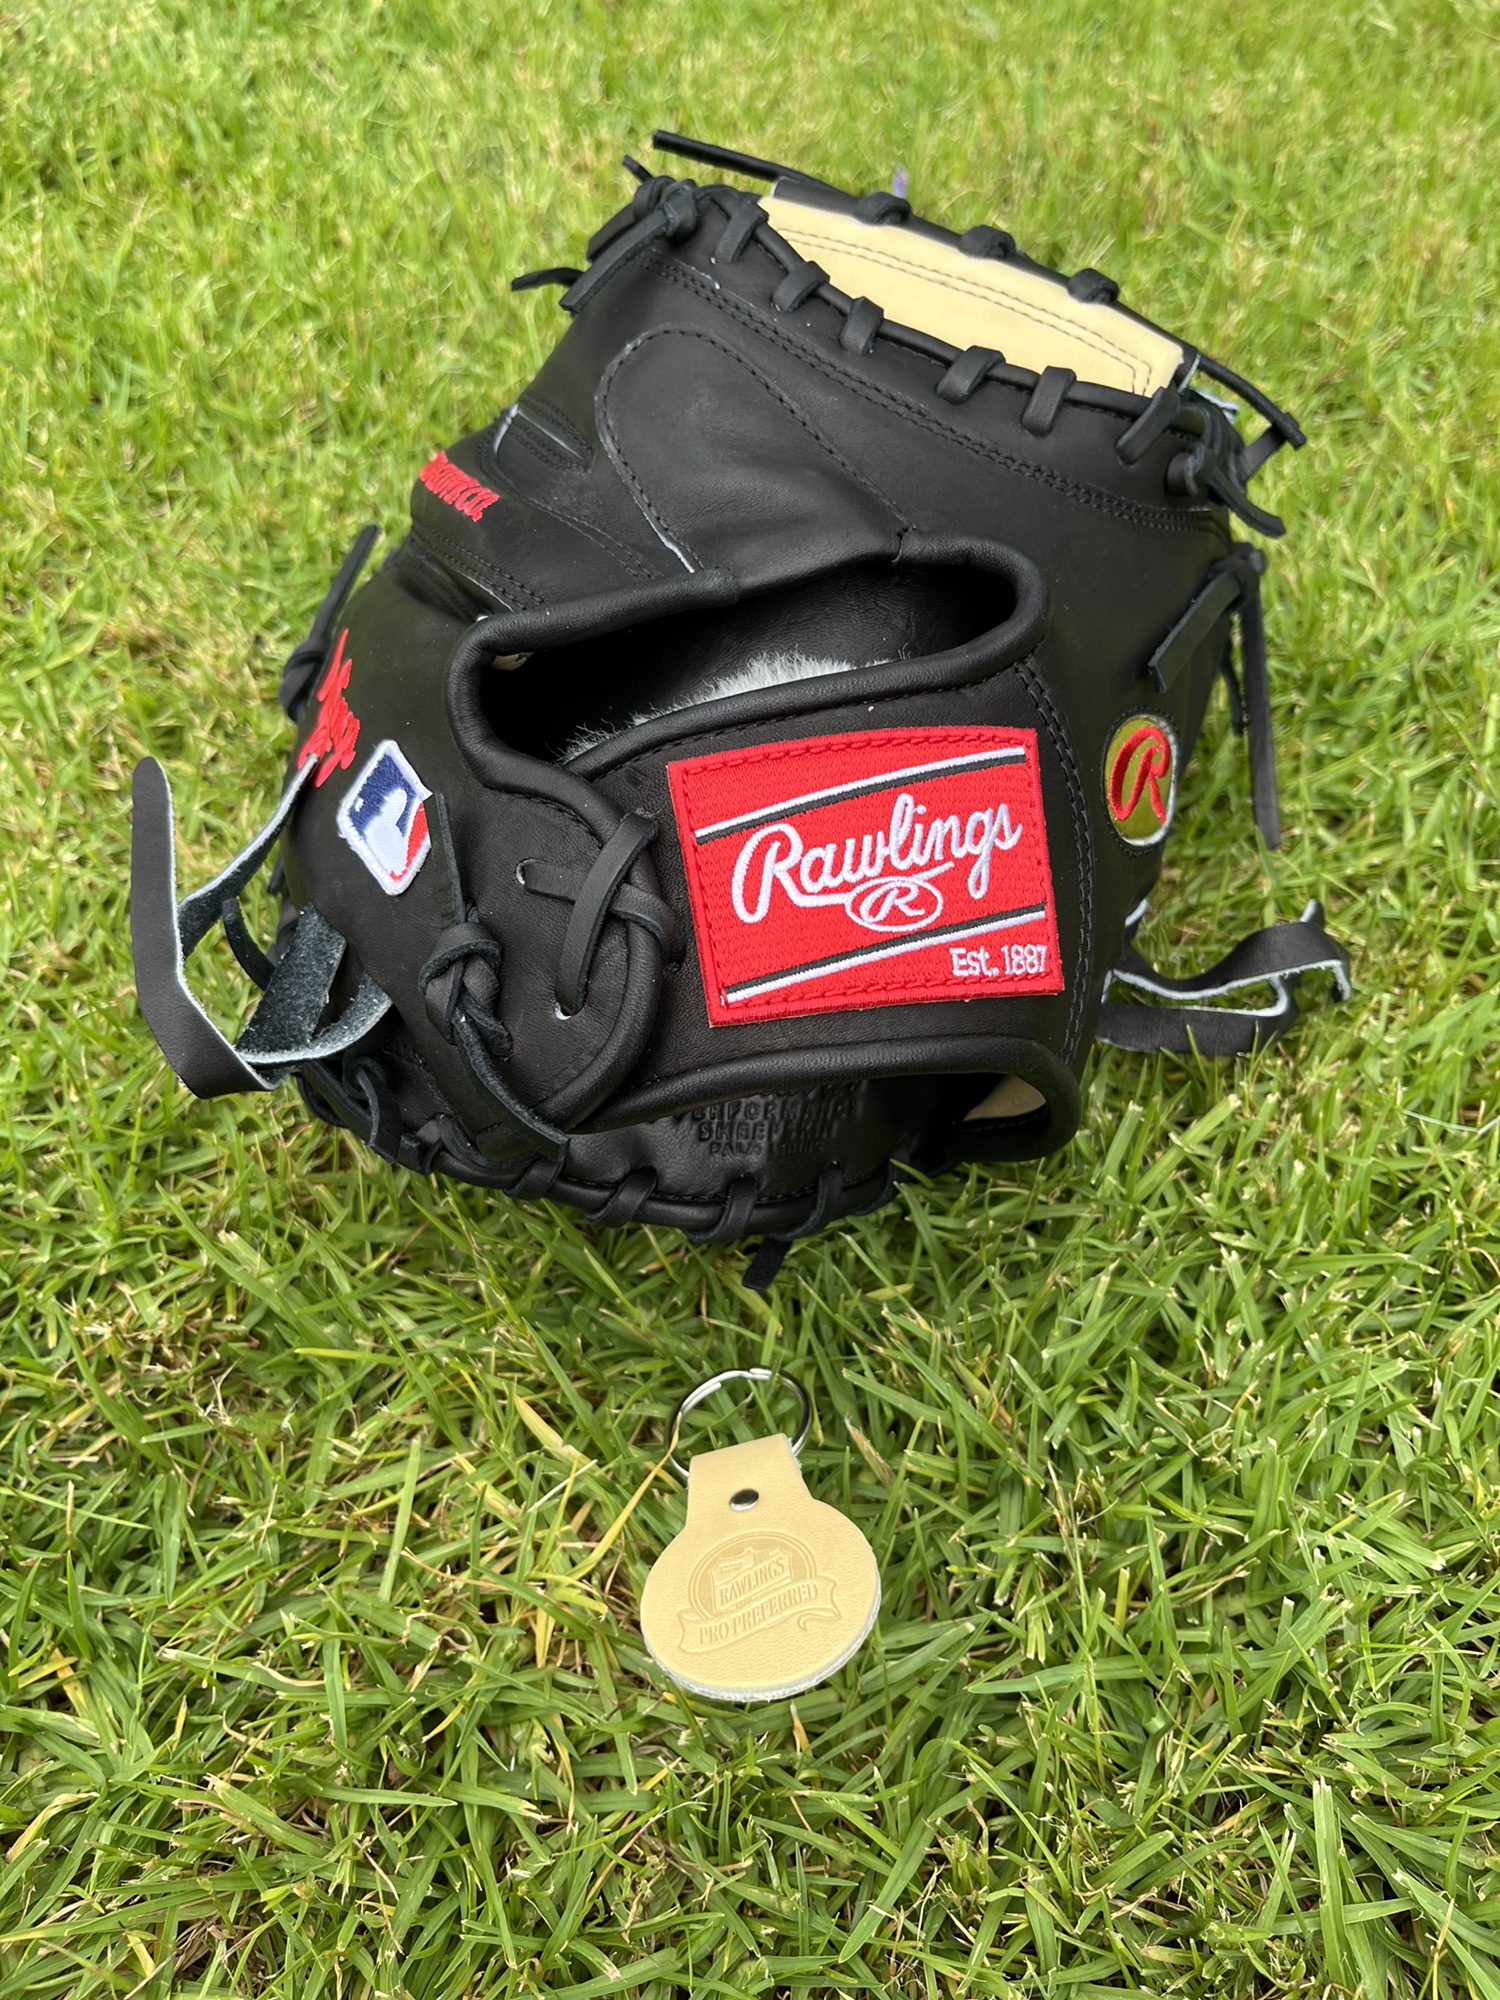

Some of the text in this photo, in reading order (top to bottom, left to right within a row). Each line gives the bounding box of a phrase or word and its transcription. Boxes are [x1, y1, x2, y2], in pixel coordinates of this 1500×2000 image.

[731, 793, 1022, 924] Rawlings
[949, 944, 1047, 977] Est. 1887
[719, 1555, 786, 1607] RAWLINGS
[698, 1581, 818, 1645] PRO PREFERRED
